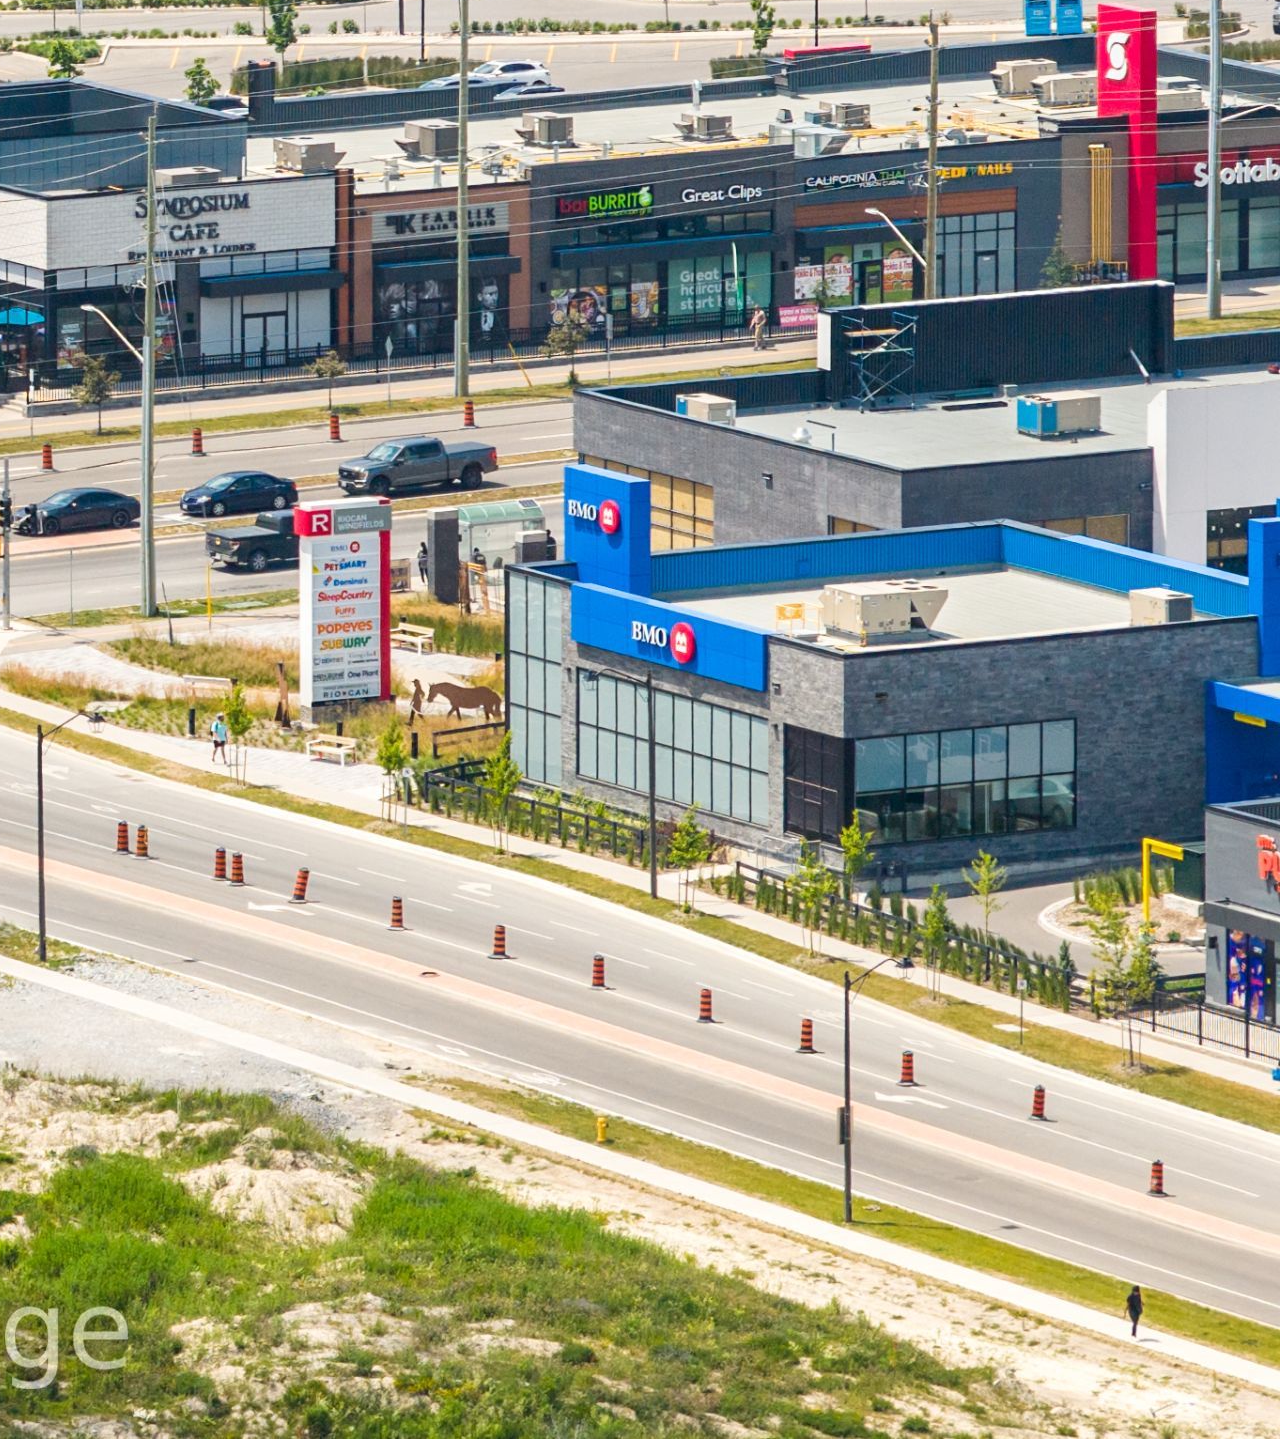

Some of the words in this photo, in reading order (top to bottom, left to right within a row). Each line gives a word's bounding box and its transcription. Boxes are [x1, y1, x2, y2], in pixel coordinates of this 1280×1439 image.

[977, 163, 1013, 176] NAILS
[1193, 157, 1280, 188] Sotiab
[806, 172, 878, 187] CALIFORNIA
[681, 188, 724, 203] Great
[728, 184, 763, 202] Clips
[453, 219, 496, 229] SUDIO
[169, 222, 220, 242] CAFE
[680, 267, 720, 283] Great
[680, 296, 716, 310] start
[567, 499, 597, 522] BMO
[311, 513, 329, 533] R
[337, 514, 368, 523] RIOCAN
[338, 520, 384, 531] WINDFIELDS
[324, 560, 367, 571] PETSMART
[333, 577, 368, 586] Domino's
[631, 621, 668, 647] BMO
[320, 636, 372, 651] SUBWAY
[347, 671, 361, 679] One
[362, 669, 379, 678] Plant
